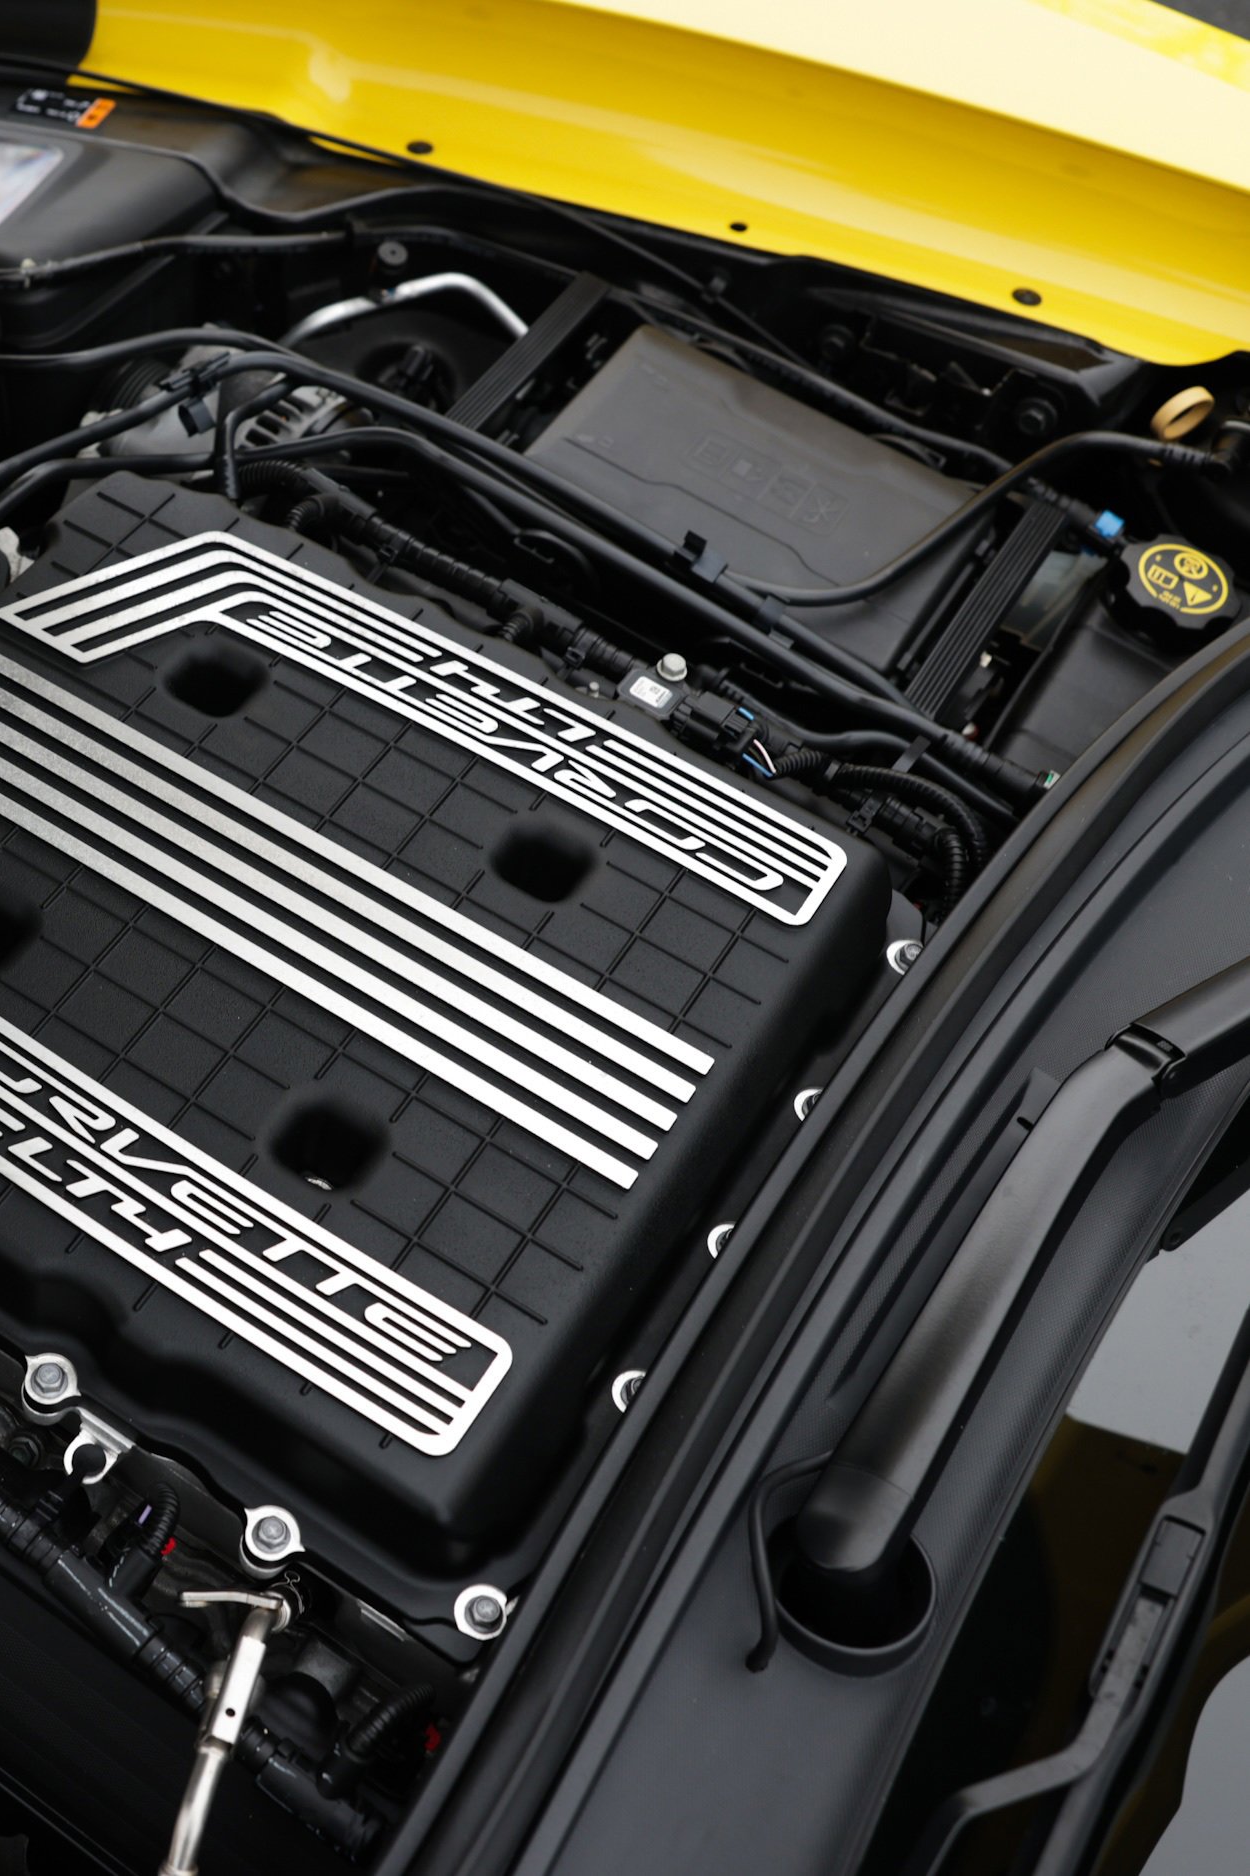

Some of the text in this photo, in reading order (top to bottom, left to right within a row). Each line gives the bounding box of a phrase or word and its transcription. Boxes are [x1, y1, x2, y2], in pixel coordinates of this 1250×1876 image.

[246, 609, 784, 891] CORVETTE
[431, 660, 596, 743] LT4
[7, 1137, 193, 1253] LT4
